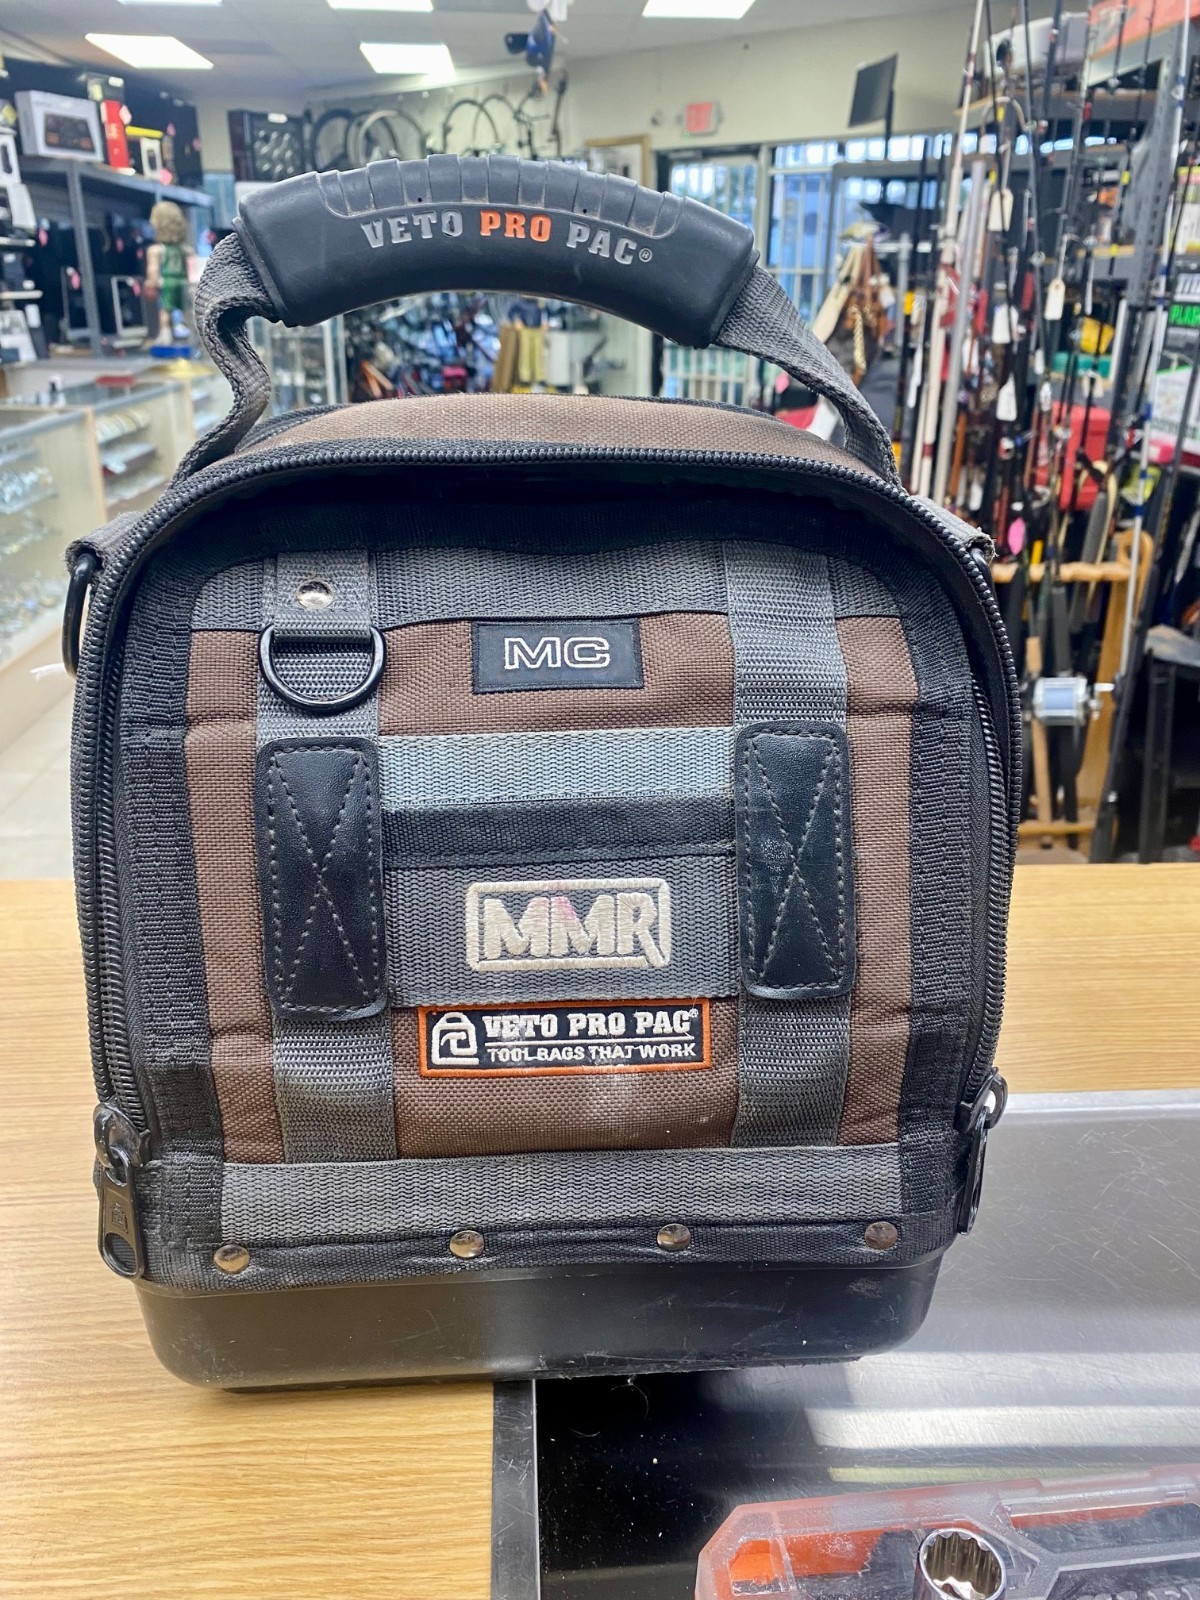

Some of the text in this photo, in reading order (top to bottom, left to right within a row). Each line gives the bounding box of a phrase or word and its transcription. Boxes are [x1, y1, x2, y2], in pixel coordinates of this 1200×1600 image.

[361, 209, 464, 249] VETO
[480, 209, 552, 243] PRO
[503, 636, 611, 670] MC
[483, 893, 667, 966] MMR
[482, 1014, 559, 1039] VETO
[567, 1010, 627, 1038] PRO
[488, 1042, 697, 1063] TOOL BAGS THAT WORK
